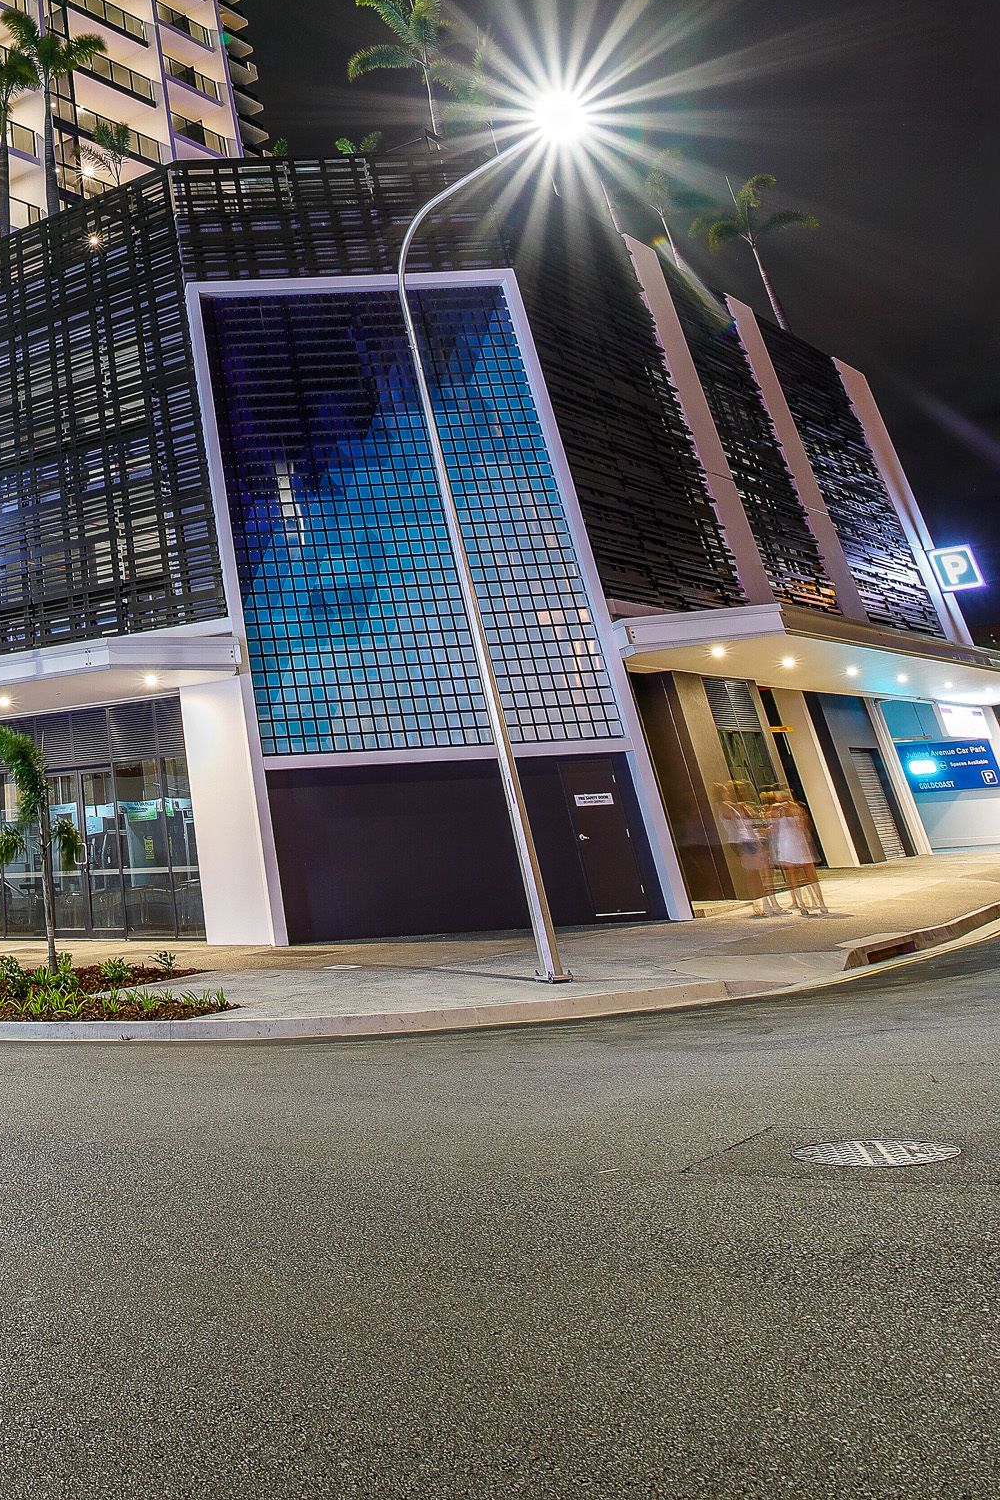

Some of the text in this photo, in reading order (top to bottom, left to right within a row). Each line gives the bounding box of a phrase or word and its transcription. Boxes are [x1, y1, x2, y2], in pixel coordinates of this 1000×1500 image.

[941, 554, 968, 585] P
[930, 749, 955, 757] Avenue
[956, 747, 969, 755] Car
[967, 758, 989, 766] Available
[984, 772, 994, 783] P
